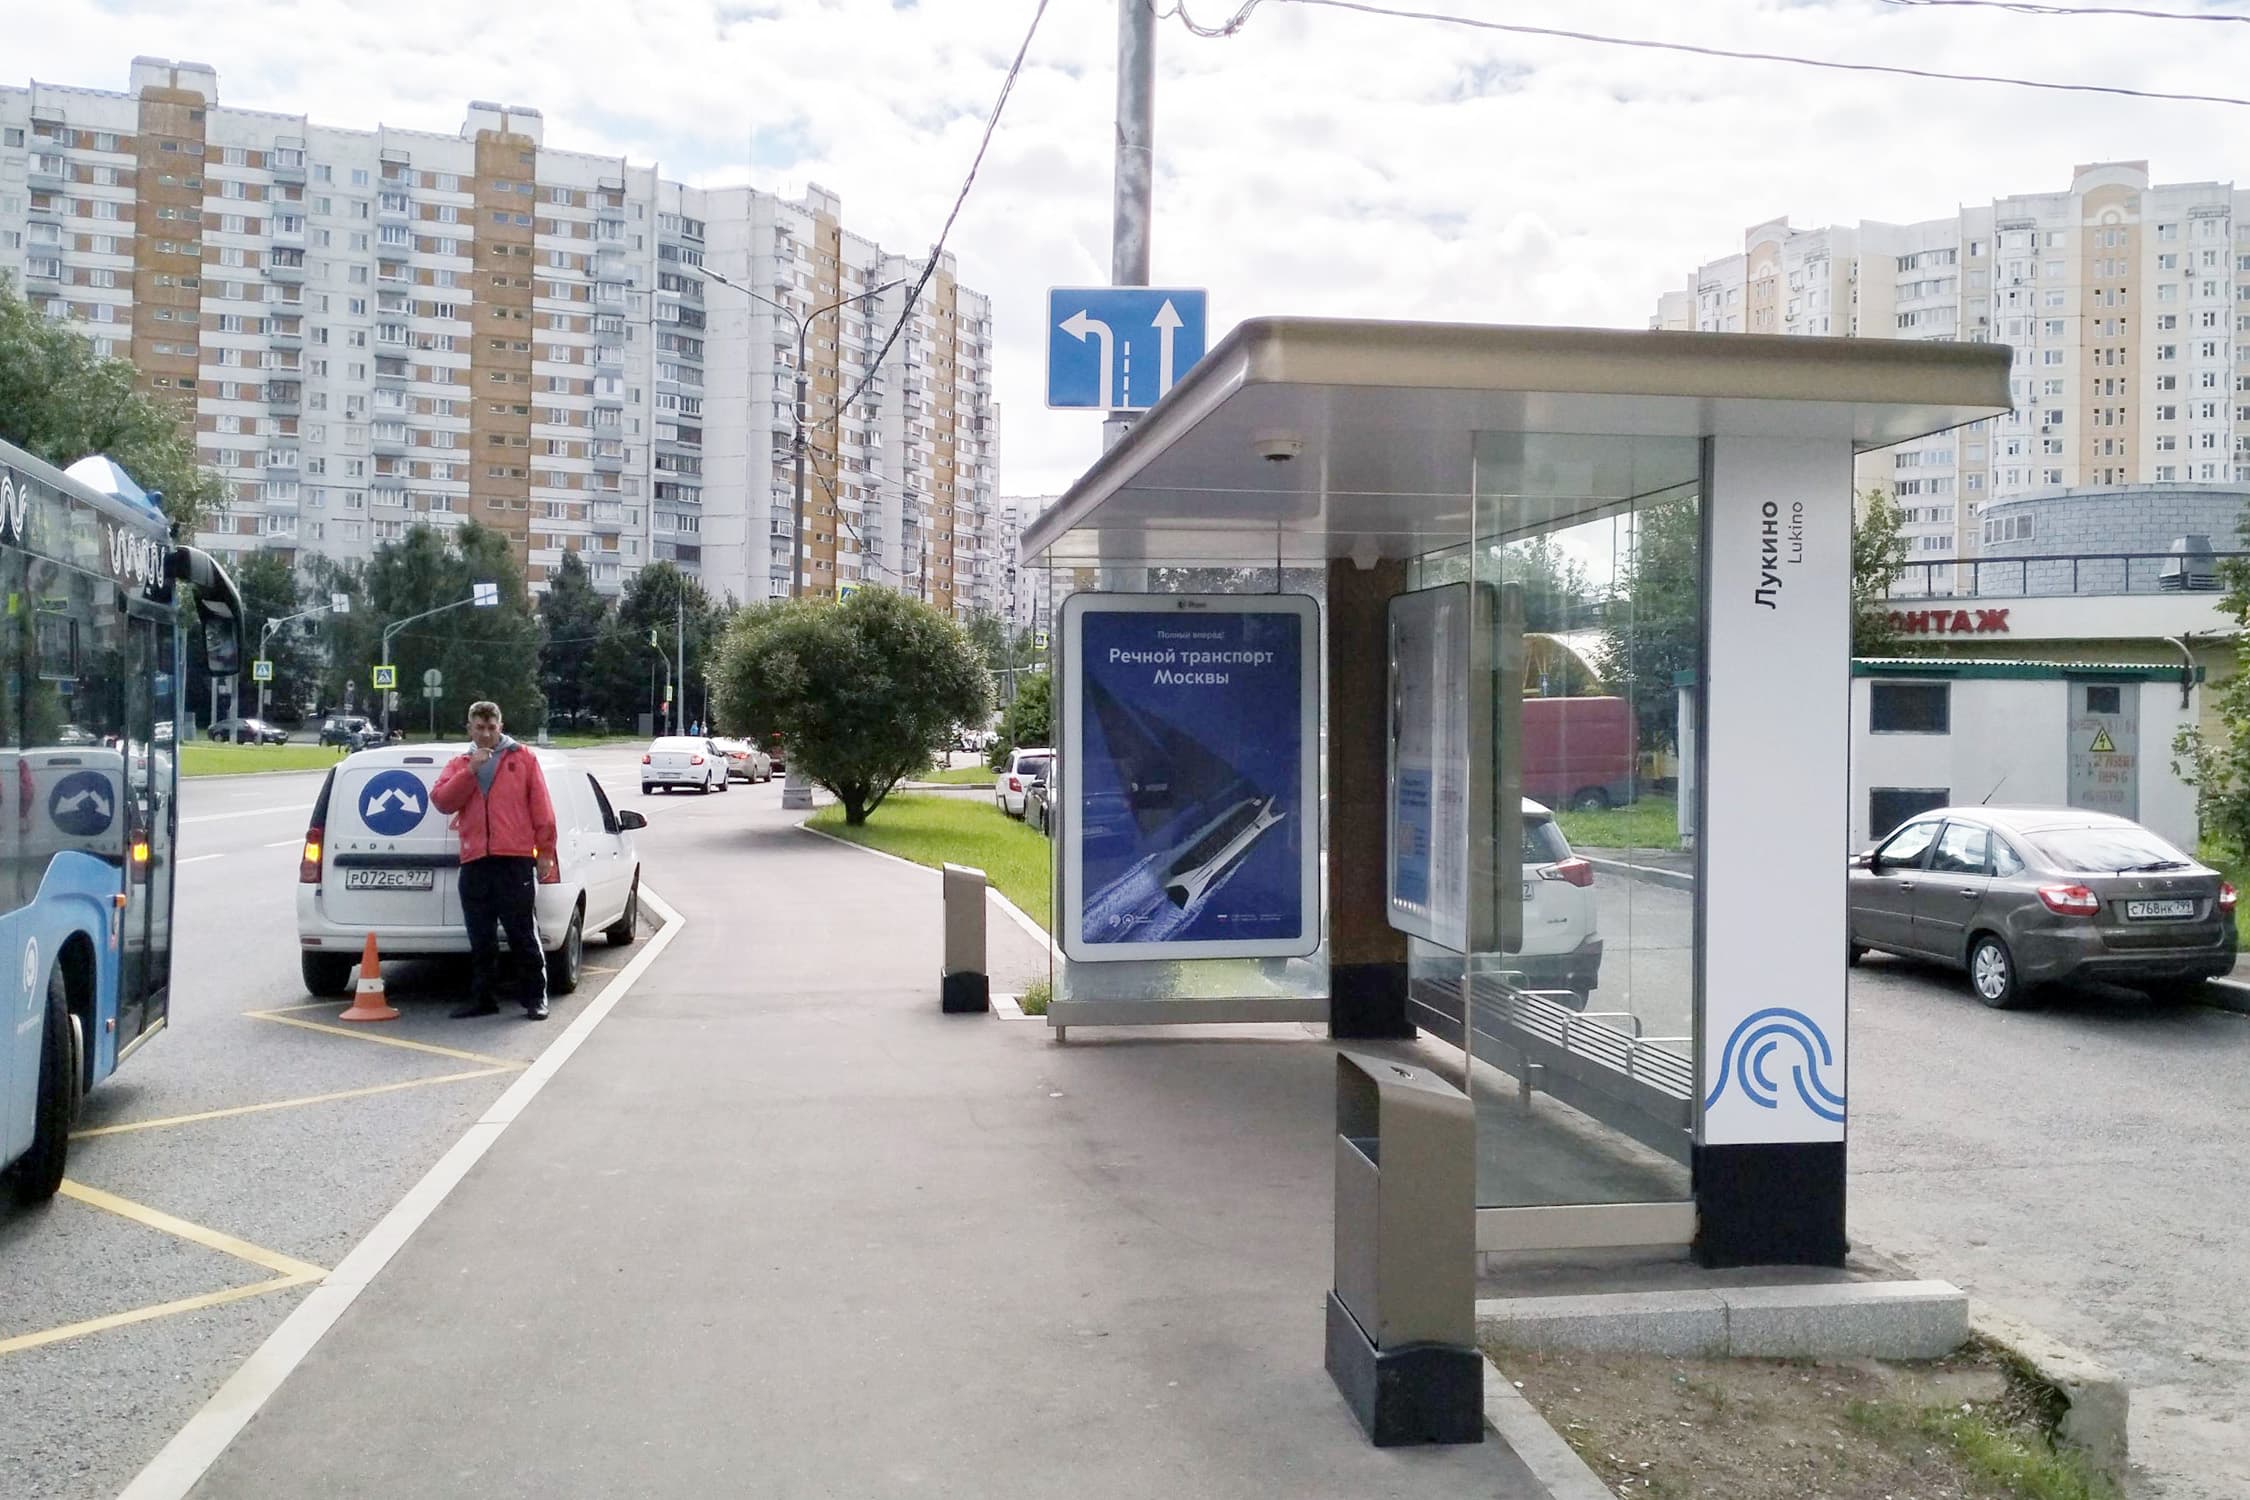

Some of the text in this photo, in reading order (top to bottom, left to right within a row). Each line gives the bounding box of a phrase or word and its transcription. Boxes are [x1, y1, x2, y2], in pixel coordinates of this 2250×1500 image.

[1788, 501, 1803, 563] Lukino
[1755, 501, 1782, 610] Лукино
[1109, 648, 1274, 666] Речной транспорт
[1153, 669, 1229, 685] Москвы
